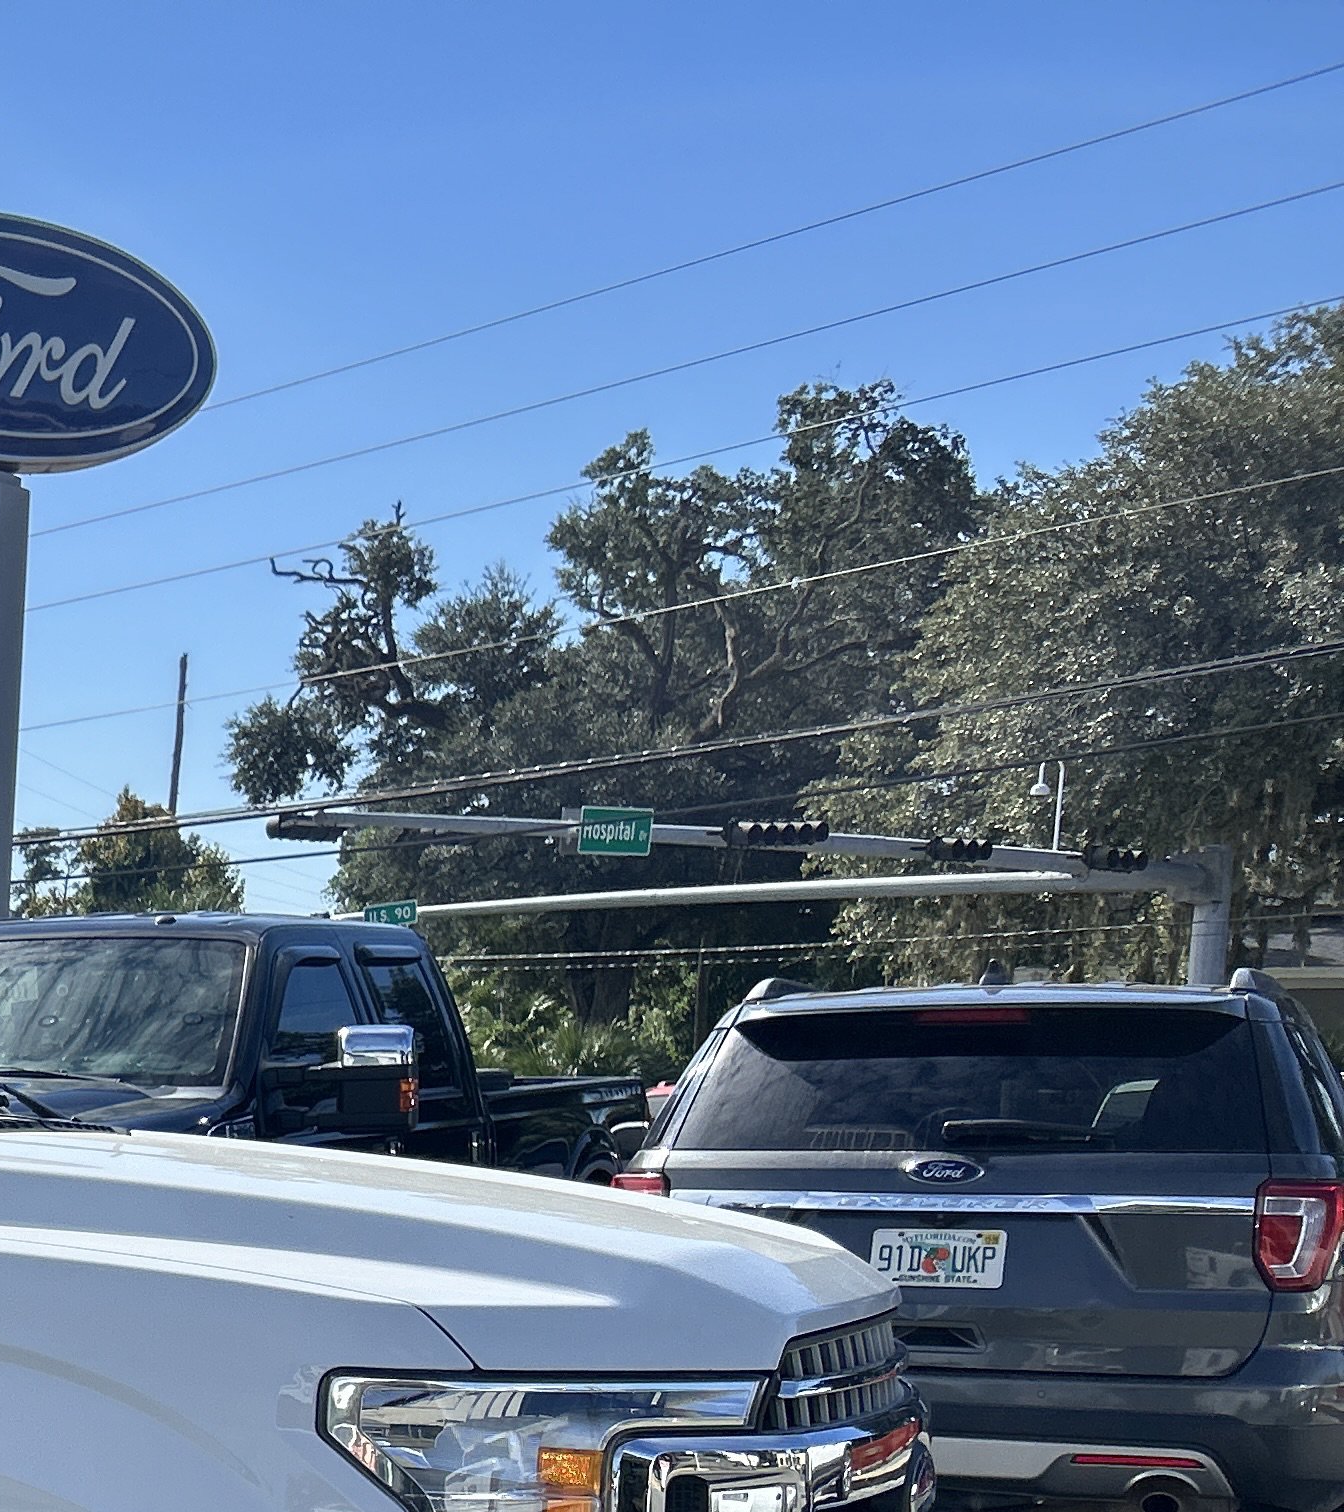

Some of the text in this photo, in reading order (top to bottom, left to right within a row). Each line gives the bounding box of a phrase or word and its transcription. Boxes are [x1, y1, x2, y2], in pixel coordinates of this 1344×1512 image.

[394, 905, 411, 920] 90
[922, 1161, 965, 1179] Ford
[877, 1244, 997, 1274] 91D UKP
